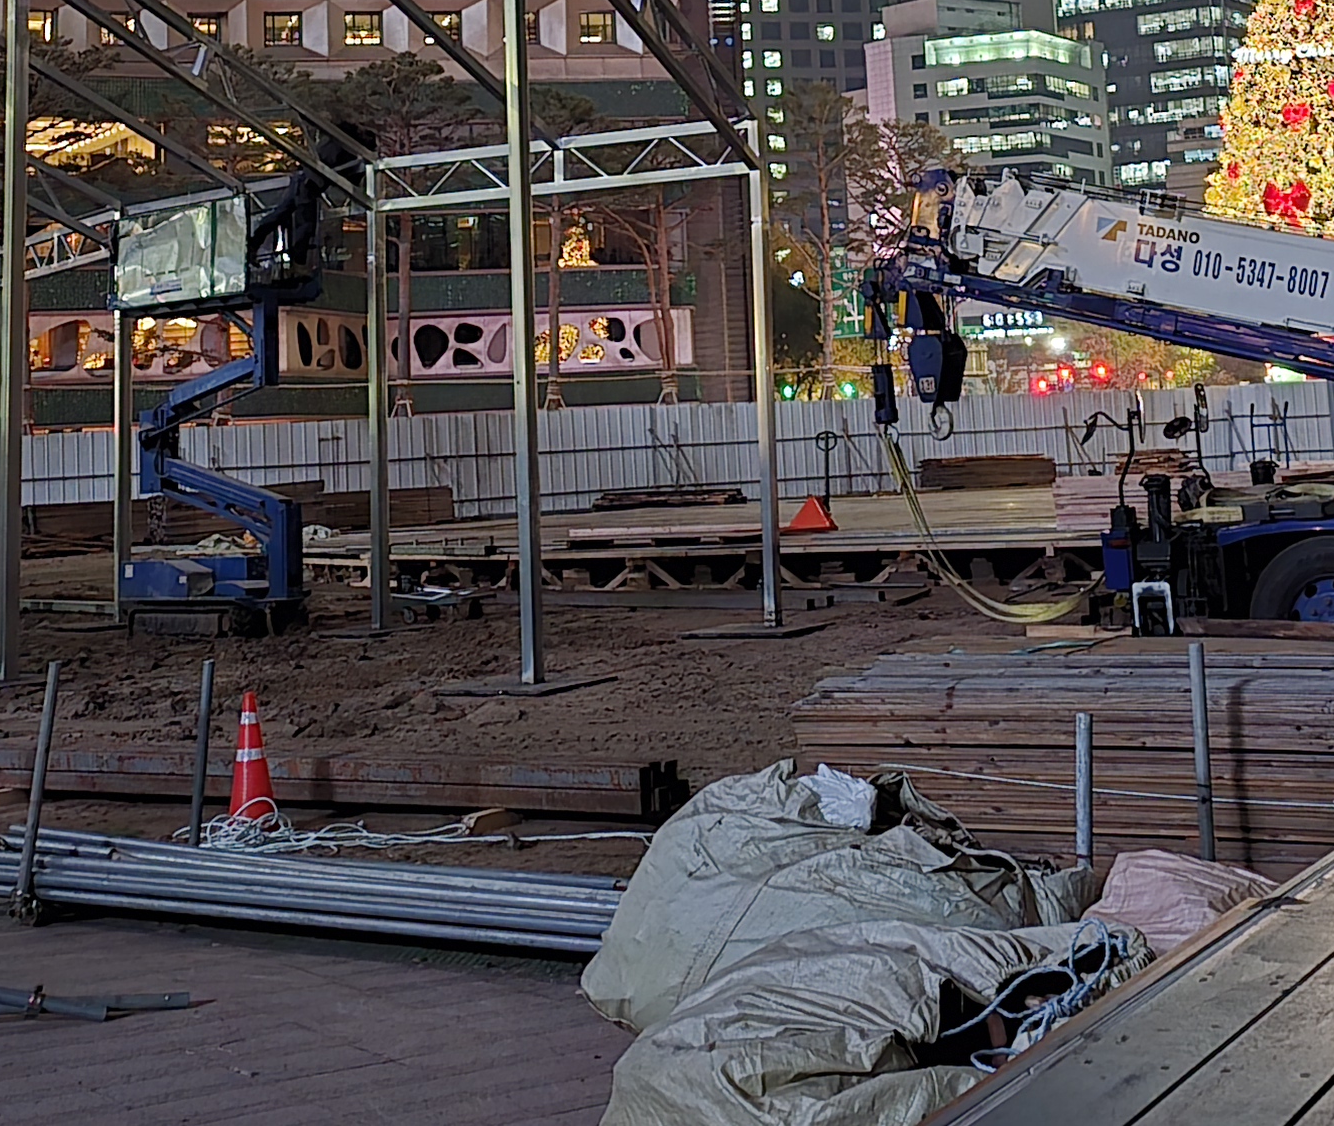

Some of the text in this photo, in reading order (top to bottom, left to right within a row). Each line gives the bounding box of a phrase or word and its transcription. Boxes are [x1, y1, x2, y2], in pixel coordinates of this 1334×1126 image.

[1232, 46, 1293, 64] Merry
[1137, 223, 1200, 244] TADANO
[1134, 239, 1330, 299] 다성 010-5347-8007
